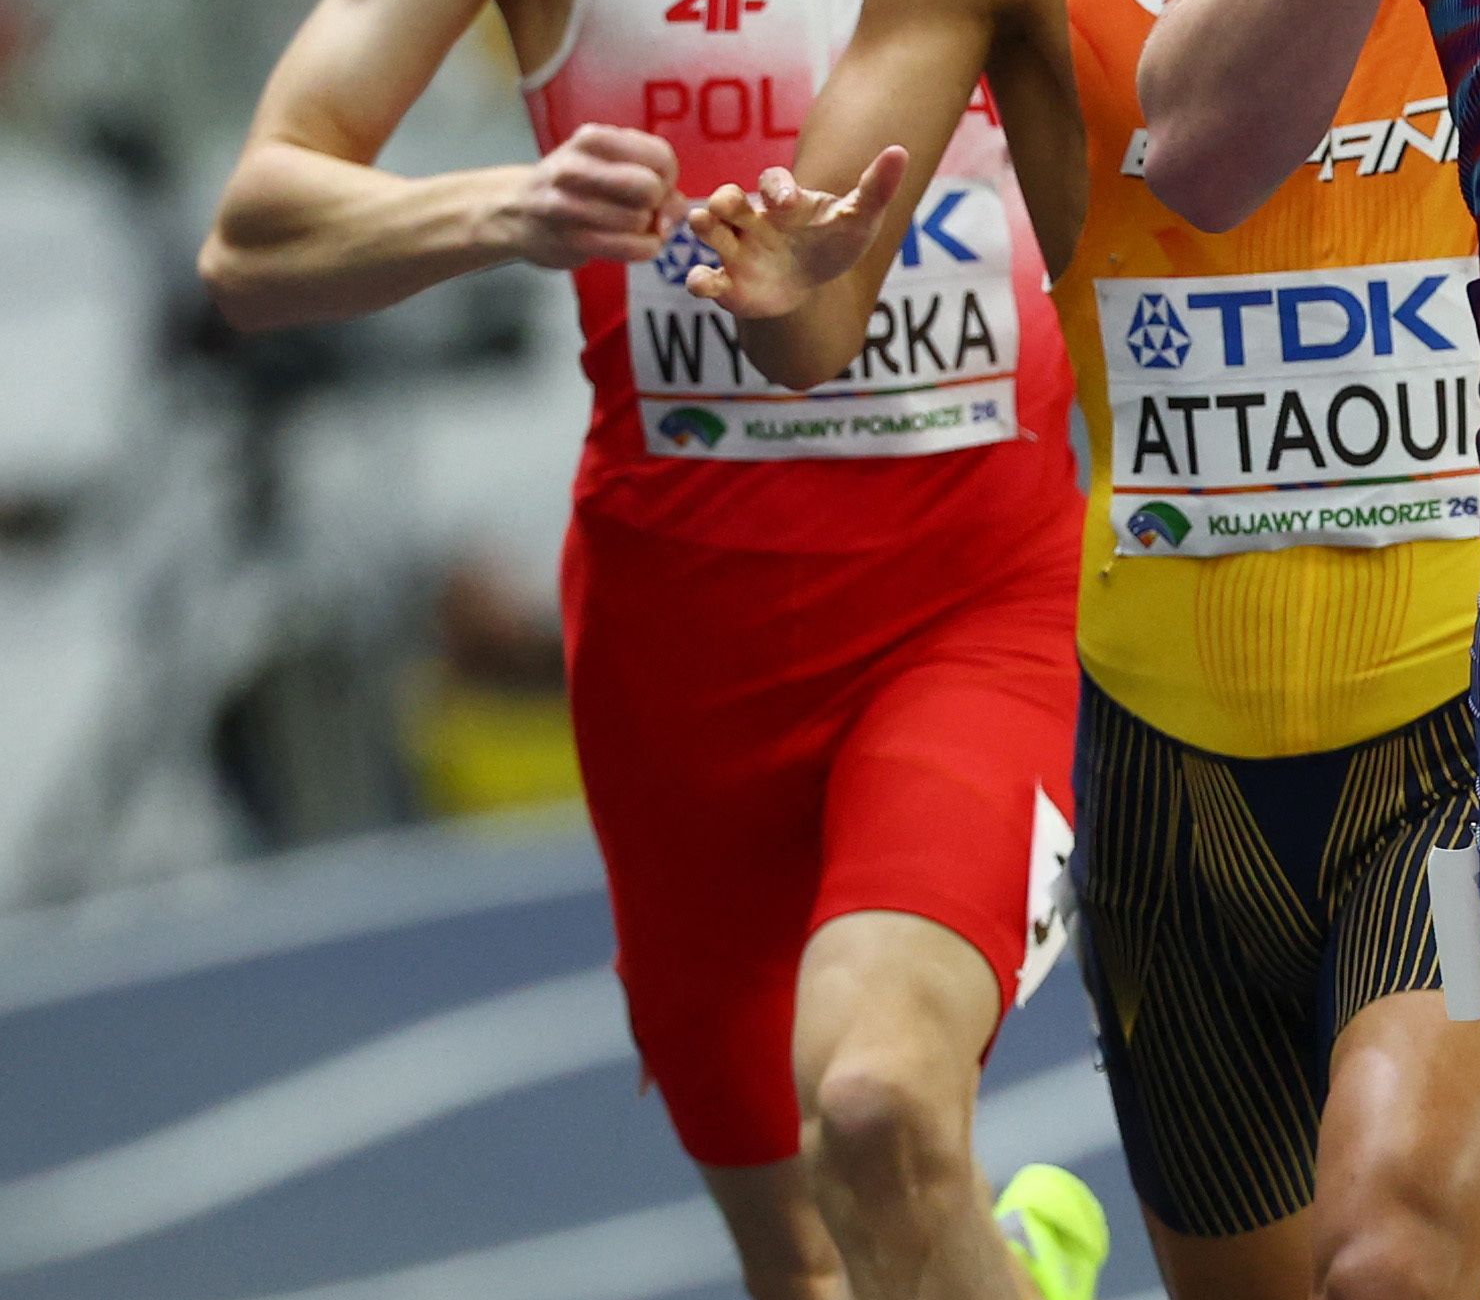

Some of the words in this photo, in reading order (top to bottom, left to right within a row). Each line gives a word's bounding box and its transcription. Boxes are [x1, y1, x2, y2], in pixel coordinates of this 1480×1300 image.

[643, 71, 1001, 142] POLA
[645, 289, 998, 385] WYRKA
[1187, 274, 1458, 367] TDK
[1131, 376, 1468, 475] ATTAOUI
[1208, 510, 1314, 536] KUJAWY
[1318, 499, 1443, 530] POMORZE
[1446, 495, 1479, 518] 26
